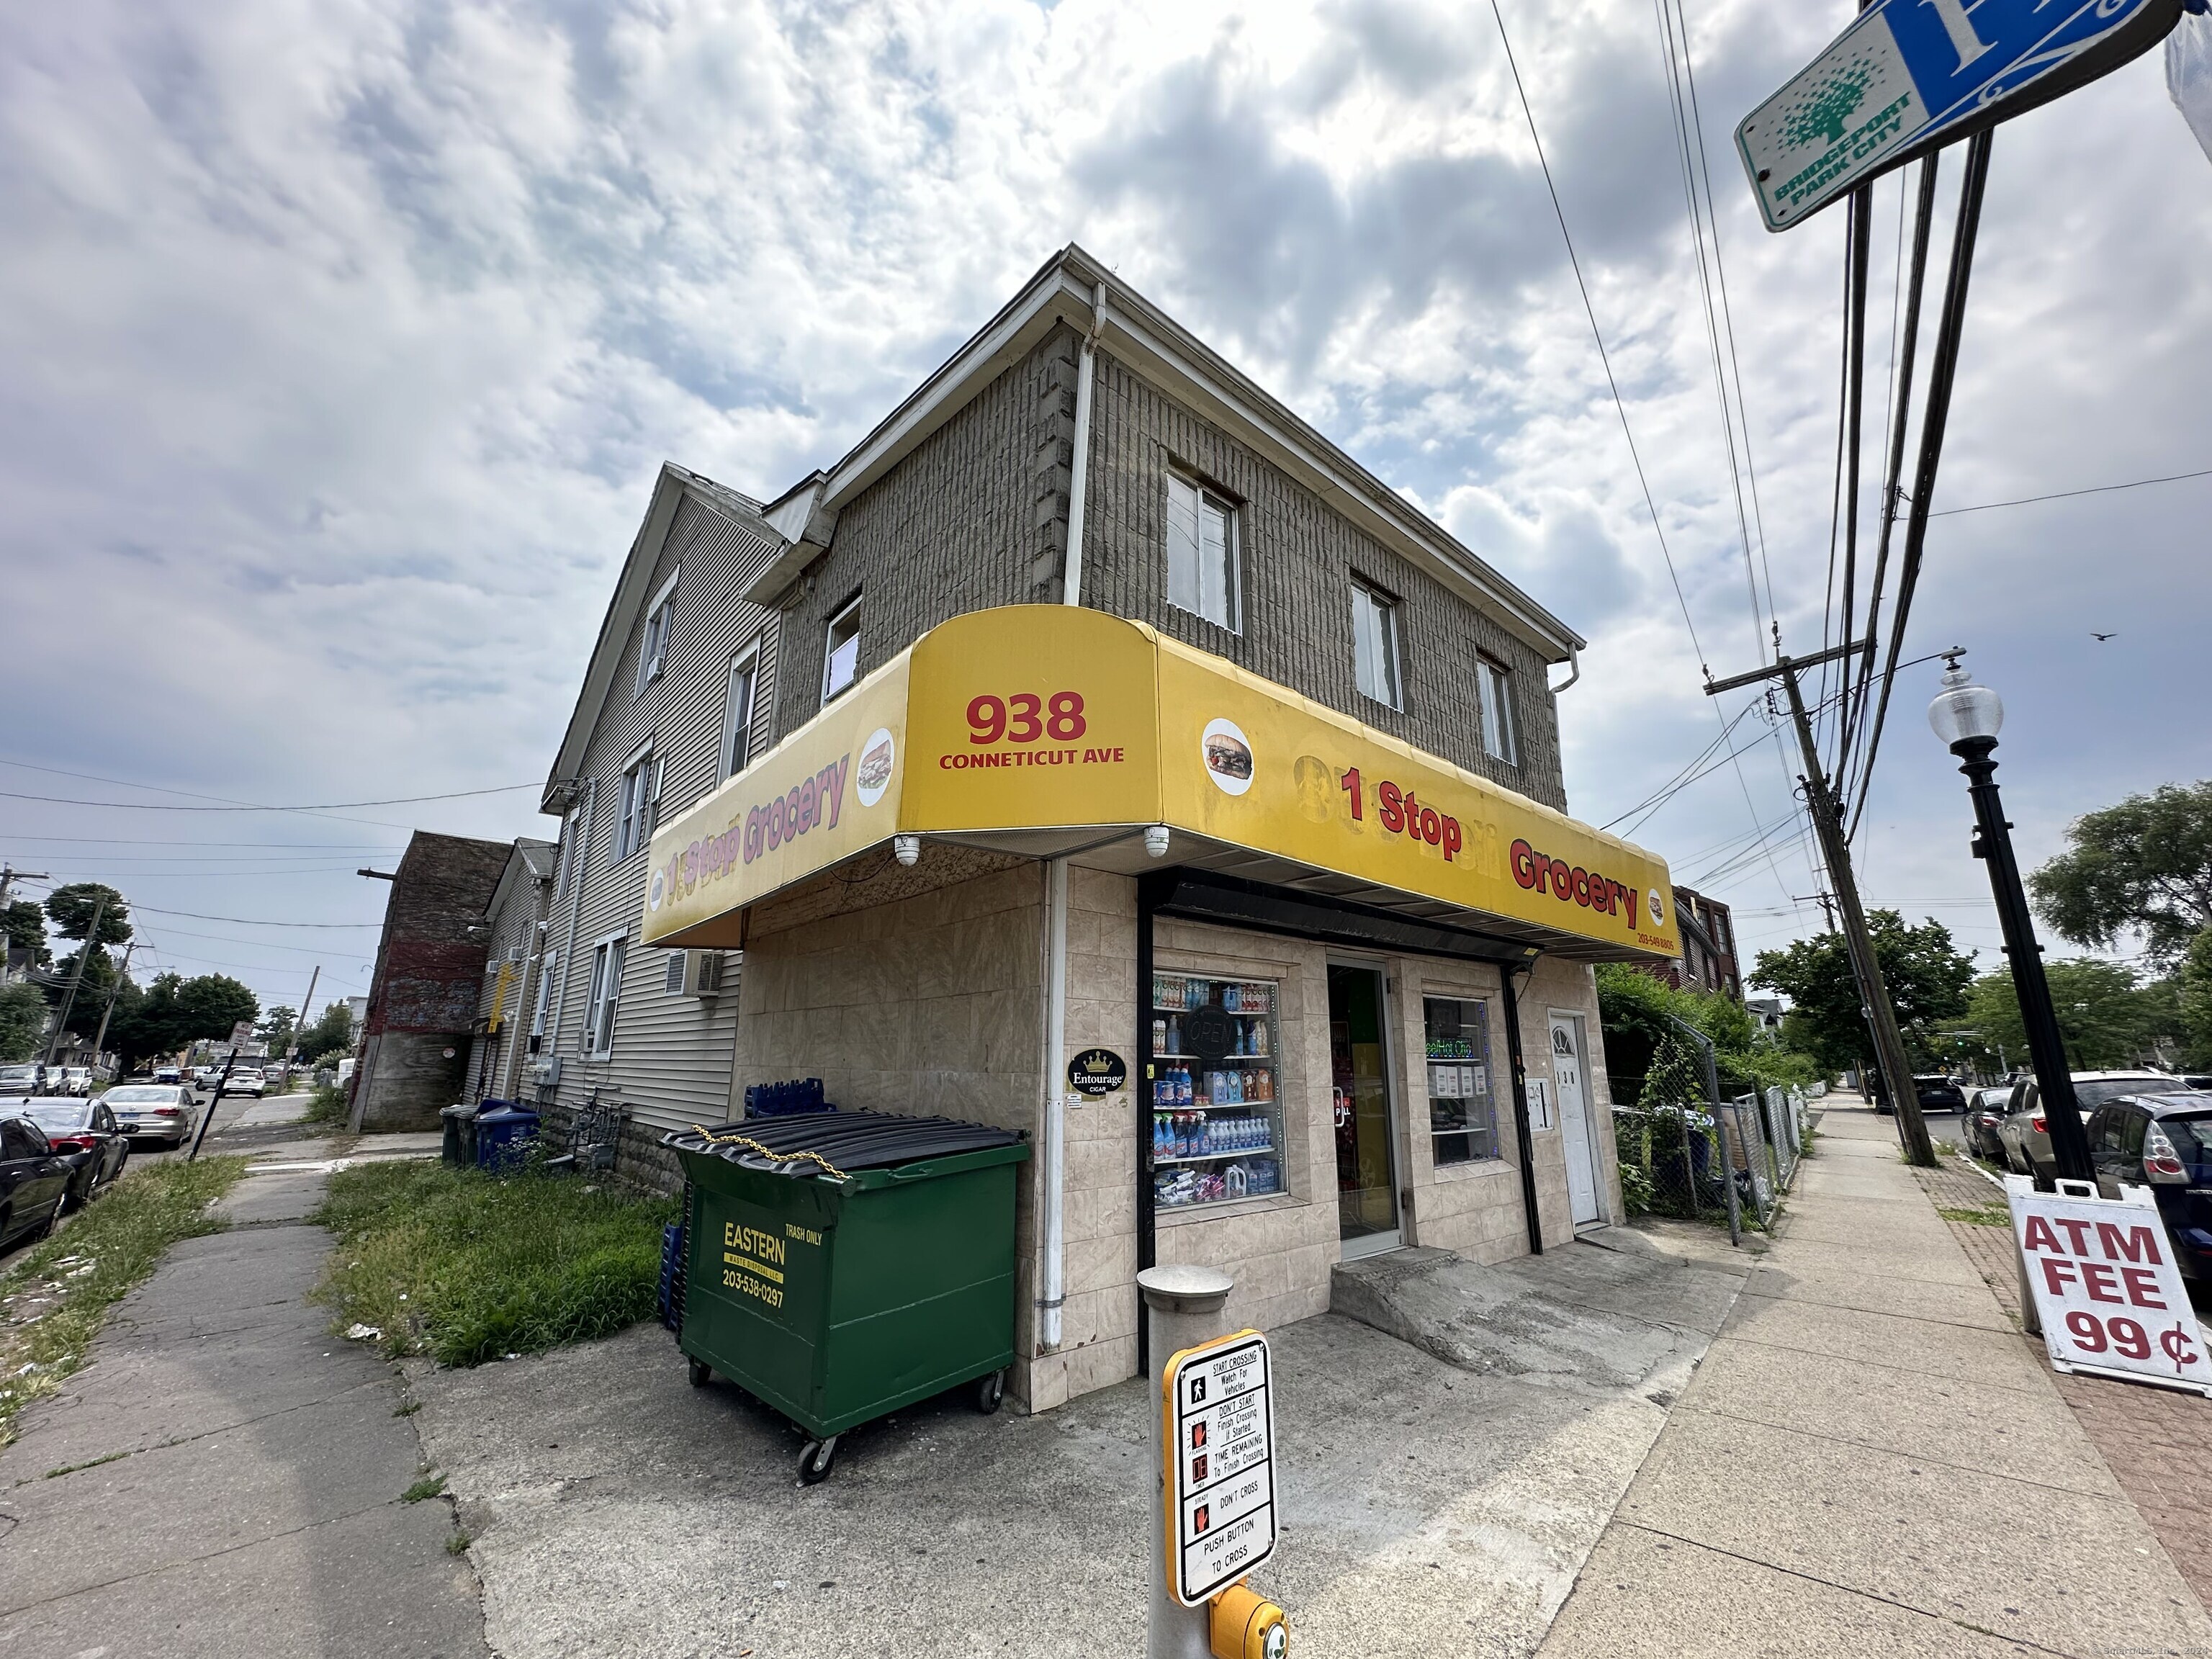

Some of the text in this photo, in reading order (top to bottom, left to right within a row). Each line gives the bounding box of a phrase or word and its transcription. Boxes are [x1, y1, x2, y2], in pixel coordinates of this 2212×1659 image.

[1774, 91, 1910, 202] BRIDGEPORT
[1791, 115, 1902, 206] PARK CITY
[966, 691, 1087, 745] 938
[939, 747, 1124, 770] CONNETICUT AVE
[667, 752, 850, 896] 1 Stop Grocery
[1341, 767, 1637, 930] 1 Stop Grocery
[1073, 1072, 1123, 1086] Entourage
[1336, 1107, 1351, 1116] PLL
[724, 1222, 785, 1265] EASTERN
[786, 1223, 822, 1246] TRASH ONLY
[2025, 1215, 2163, 1265] ATM
[729, 1255, 778, 1280] WASTE DISPOSAL LLC
[722, 1269, 783, 1308] 203-538-0297
[2041, 1257, 2167, 1310] FEE
[1213, 1350, 1256, 1374] START CROSSING
[1221, 1372, 1236, 1385] Watch
[1224, 1382, 1245, 1395] Vehicles
[1219, 1393, 1254, 1416] DON'T START
[1218, 1408, 1257, 1431] Finish Crossing
[1233, 1421, 1251, 1437] Started
[1214, 1448, 1263, 1478] To Finish Crossing
[1215, 1434, 1262, 1464] TIME REMAINING
[1195, 1493, 1208, 1505] STEADY
[1220, 1480, 1258, 1509] DON'T CROSS
[1204, 1518, 1254, 1555] PUSH BUTTON
[1213, 1545, 1248, 1574] TO CROSS
